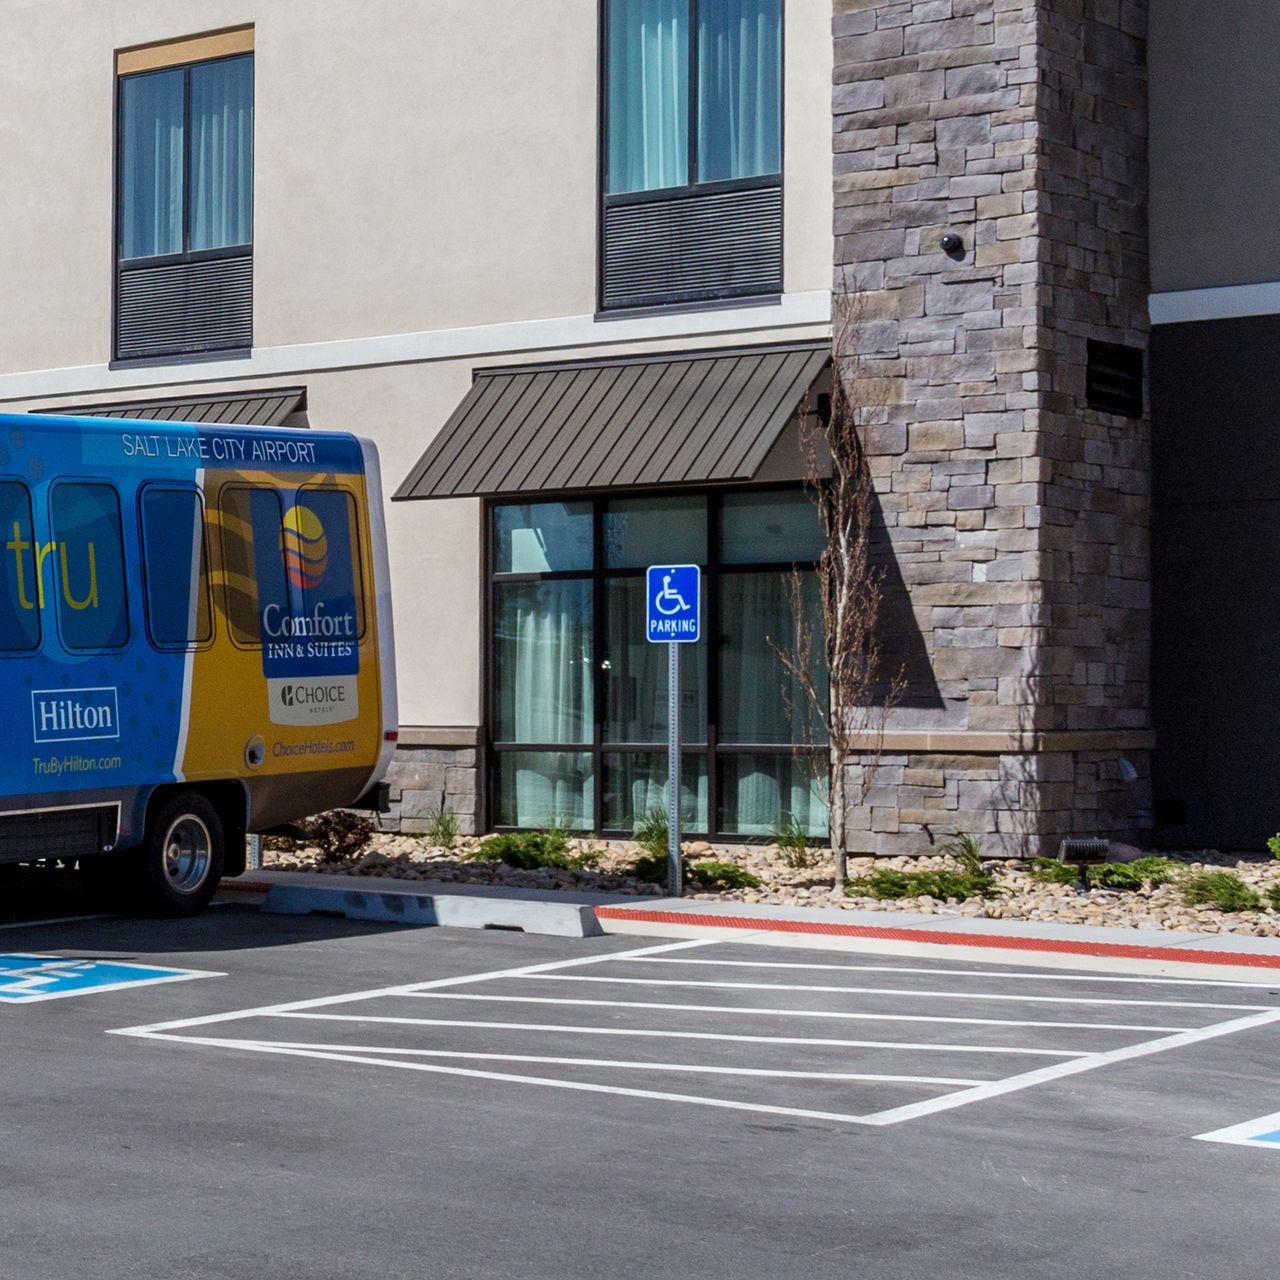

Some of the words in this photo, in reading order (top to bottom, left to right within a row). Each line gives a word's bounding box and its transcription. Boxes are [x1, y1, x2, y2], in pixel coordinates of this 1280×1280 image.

[122, 433, 161, 457] SALT
[165, 436, 210, 459] LAKE
[212, 437, 246, 460] CITY
[251, 440, 317, 463] AIRPORT
[6, 521, 99, 610] tru
[263, 601, 353, 638] Comfort
[650, 618, 696, 633] PARKING
[268, 643, 295, 658] INN
[296, 643, 305, 658] &
[307, 641, 352, 658] SUITES
[295, 685, 346, 704] CHOICE
[39, 699, 113, 731] Hilton
[272, 738, 356, 757] ChoiceHotels.com
[32, 754, 123, 777] TruByHilton.com
